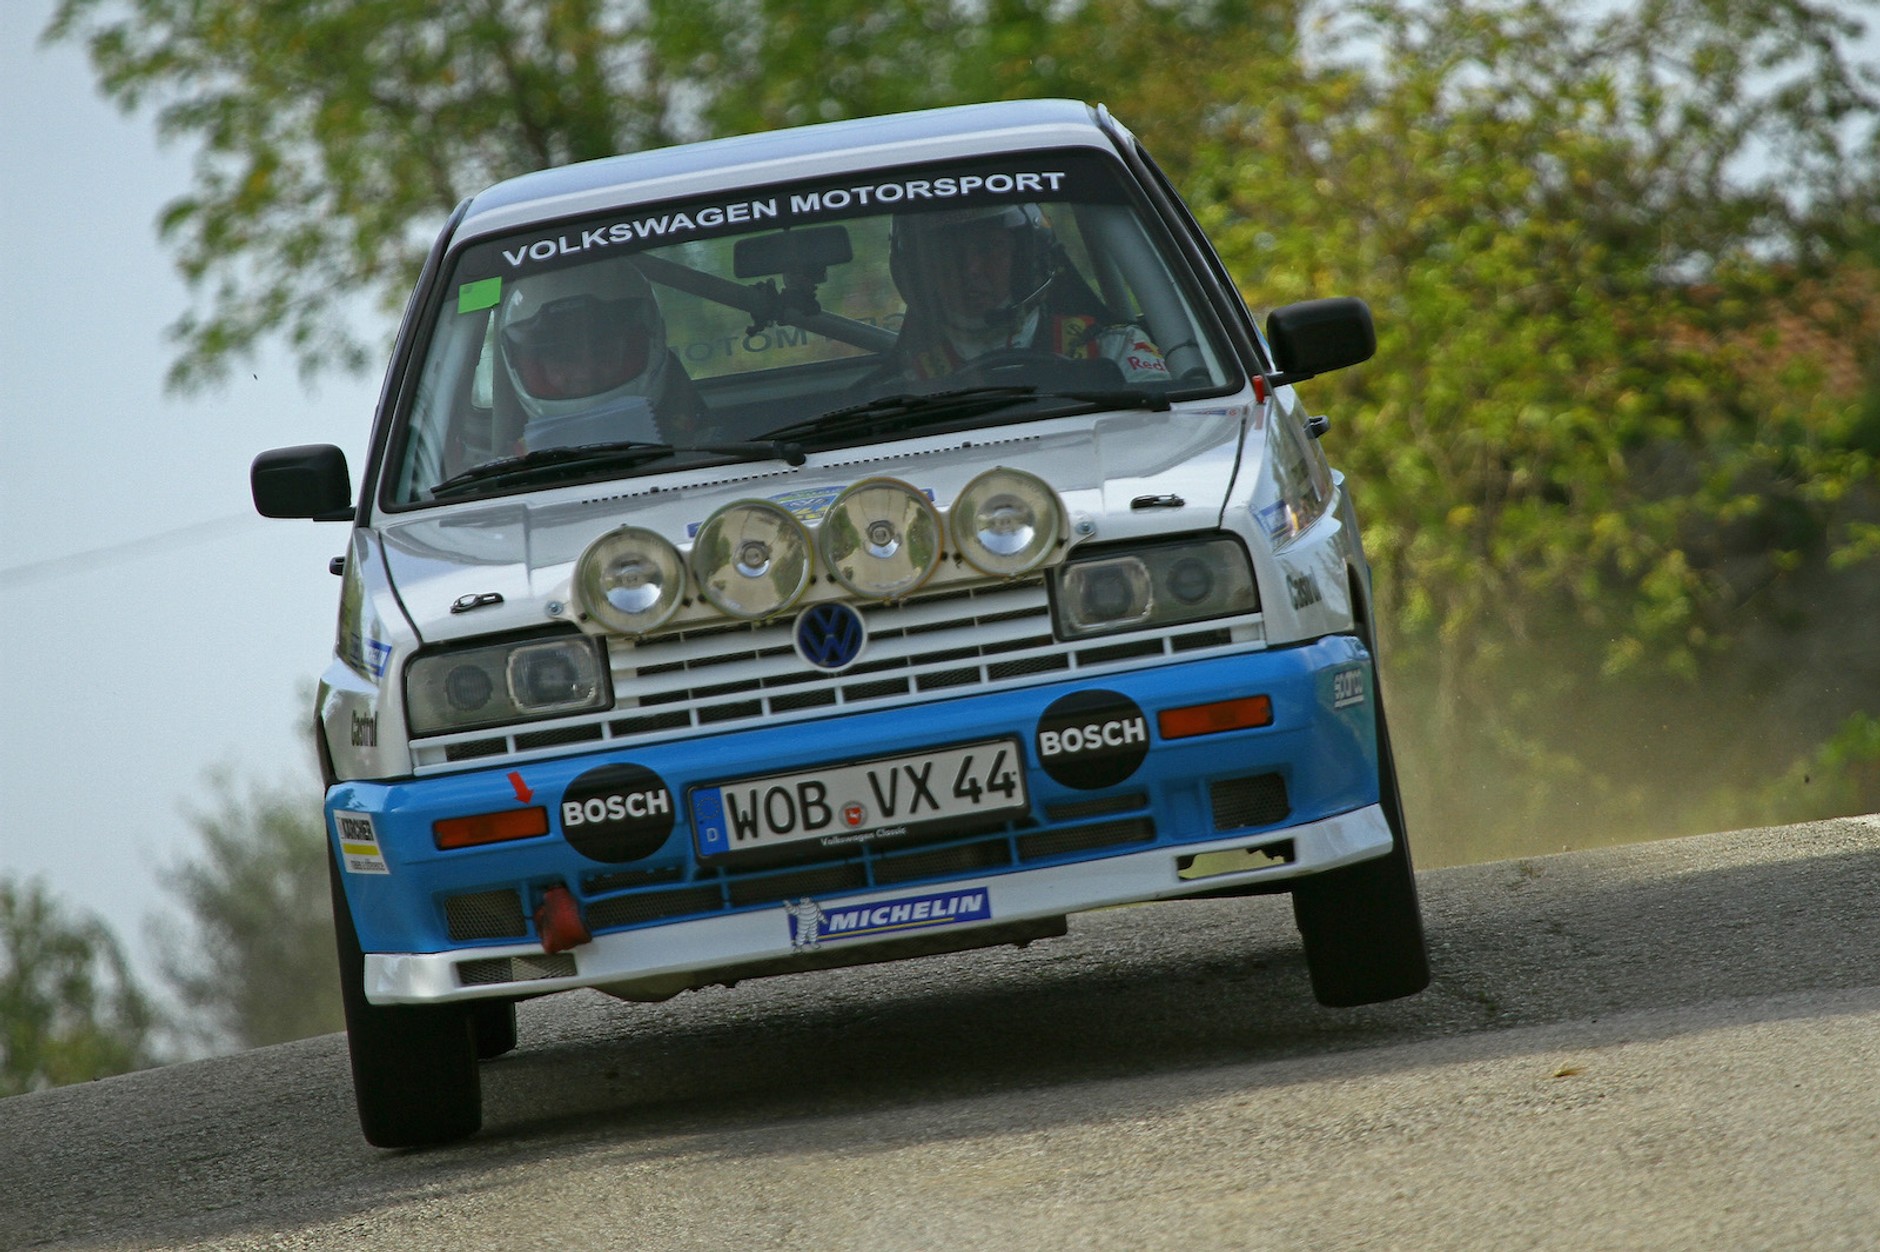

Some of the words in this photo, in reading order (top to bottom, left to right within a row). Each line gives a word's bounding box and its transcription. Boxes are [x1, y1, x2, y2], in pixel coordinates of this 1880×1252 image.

[502, 198, 778, 267] VOLKSWAGEN
[790, 171, 1066, 213] MOTORSPORT
[1039, 716, 1146, 756] BOSCH
[561, 788, 669, 827] BOSCH
[726, 780, 833, 840] WOB
[867, 761, 940, 814] VX
[952, 750, 1016, 804] 44
[707, 827, 719, 842] D
[820, 833, 874, 846] Volkswagen
[876, 826, 907, 838] Classic
[828, 893, 982, 932] MICHELIN
